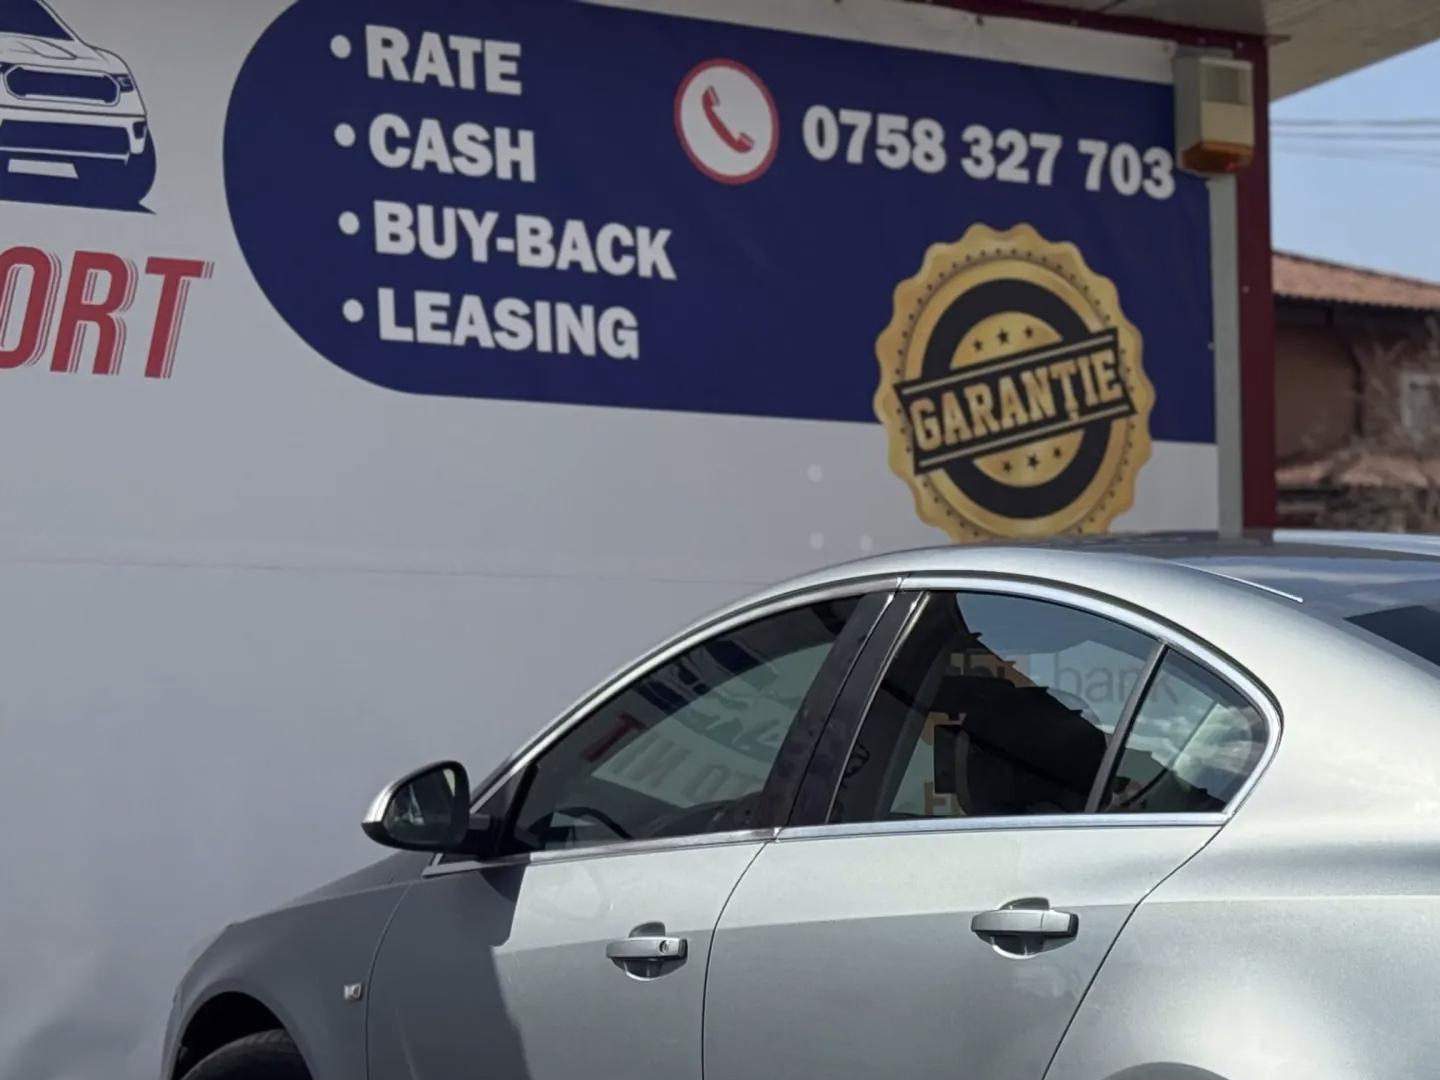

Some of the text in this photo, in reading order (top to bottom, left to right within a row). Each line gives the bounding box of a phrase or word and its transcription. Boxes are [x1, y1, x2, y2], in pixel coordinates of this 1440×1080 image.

[365, 23, 523, 95] RATE
[368, 113, 536, 182] CASH
[801, 104, 1176, 199] 0758 327 703
[374, 200, 677, 280] BUY-BACK
[377, 287, 640, 360] LEASING
